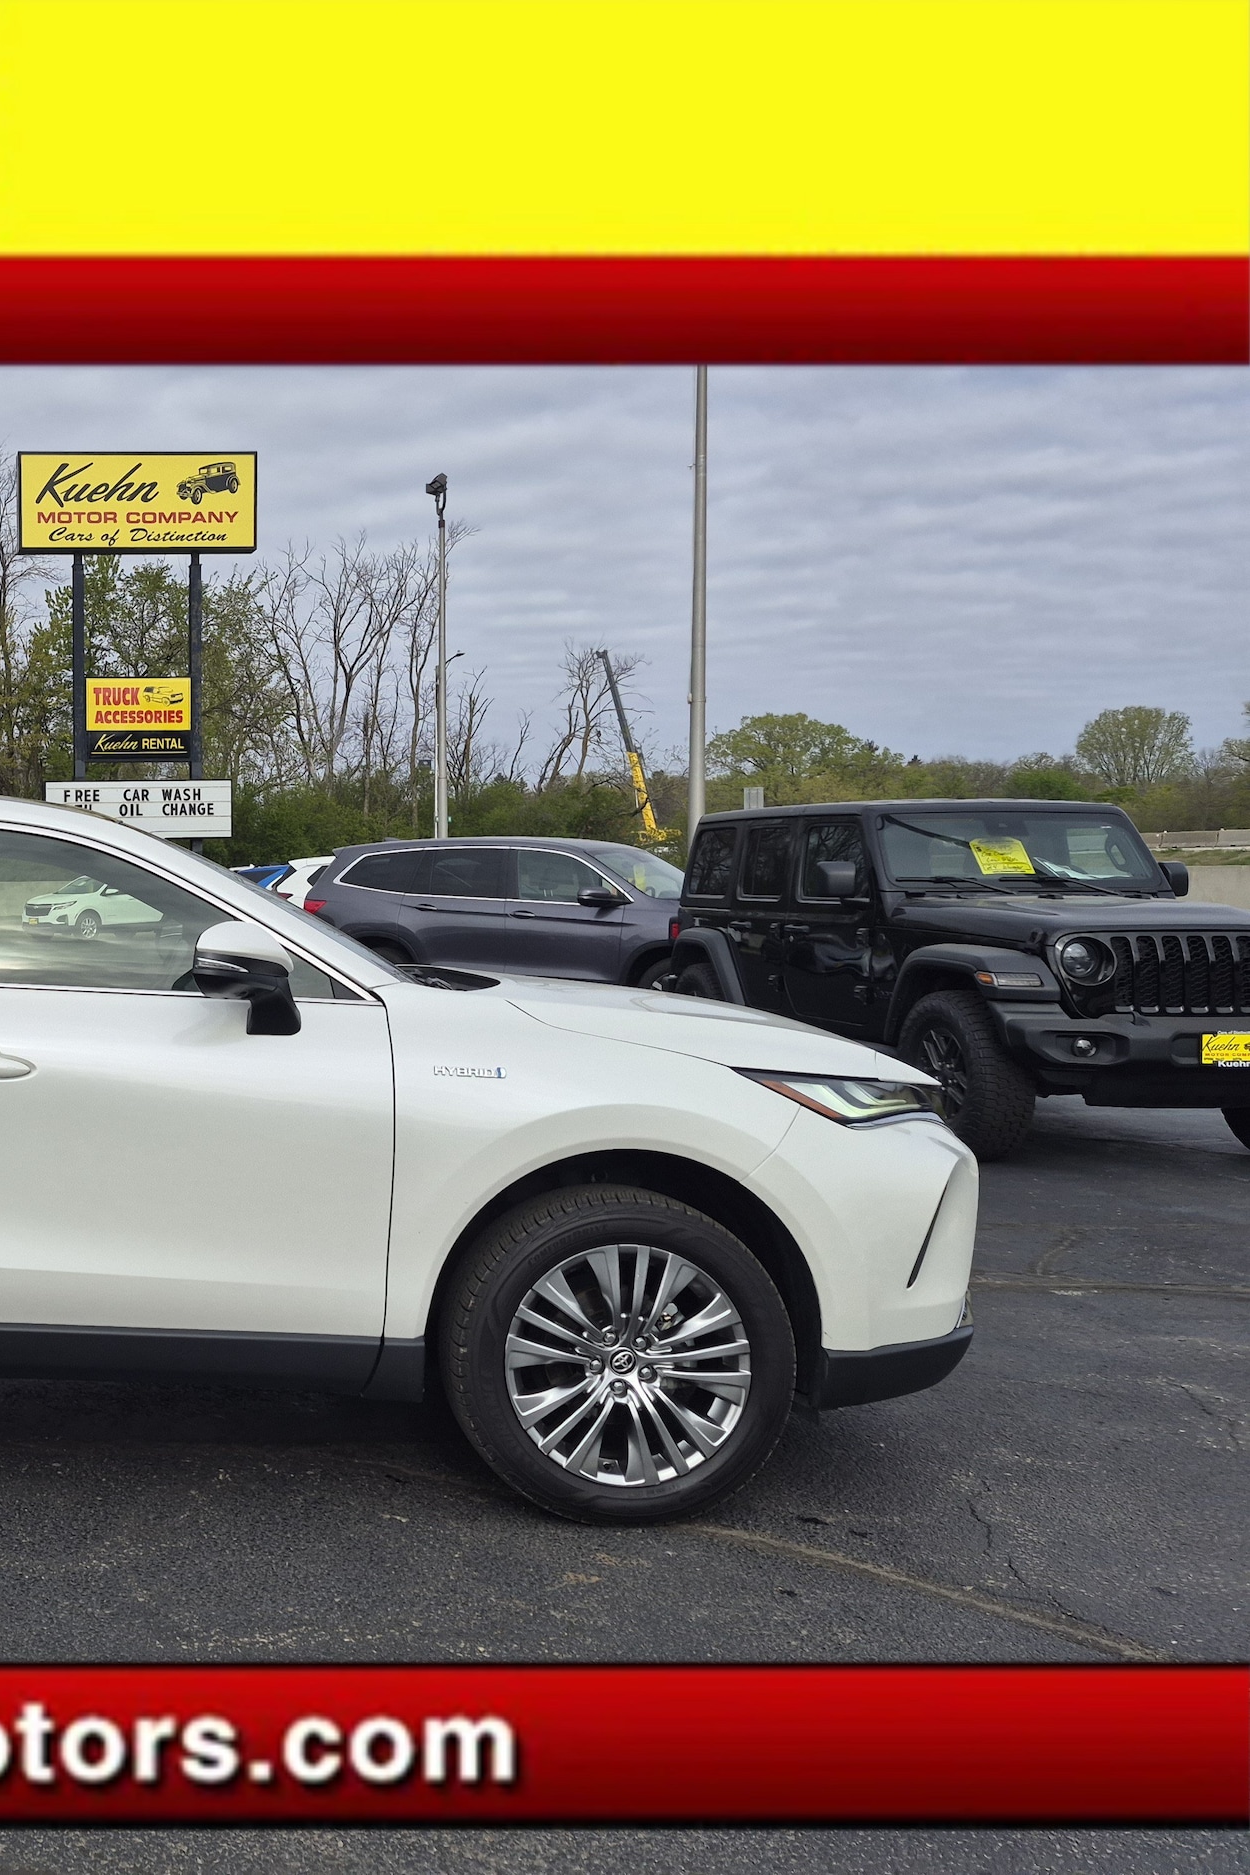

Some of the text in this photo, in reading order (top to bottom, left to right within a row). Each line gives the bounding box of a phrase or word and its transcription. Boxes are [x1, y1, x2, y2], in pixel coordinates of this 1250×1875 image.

[35, 462, 159, 508] Kuehn
[37, 511, 239, 524] MOTOR COMPANY
[48, 527, 228, 546] Cars of Distinction
[93, 687, 140, 706] TRUCK
[94, 710, 183, 724] ACCESSORIES
[94, 734, 184, 752] Kuehn RENTAL
[64, 788, 201, 802] FREE CAR WASH
[119, 803, 214, 816] OIL CHANGE
[1202, 1036, 1240, 1053] Kuehn
[434, 1065, 496, 1078] HYBRID
